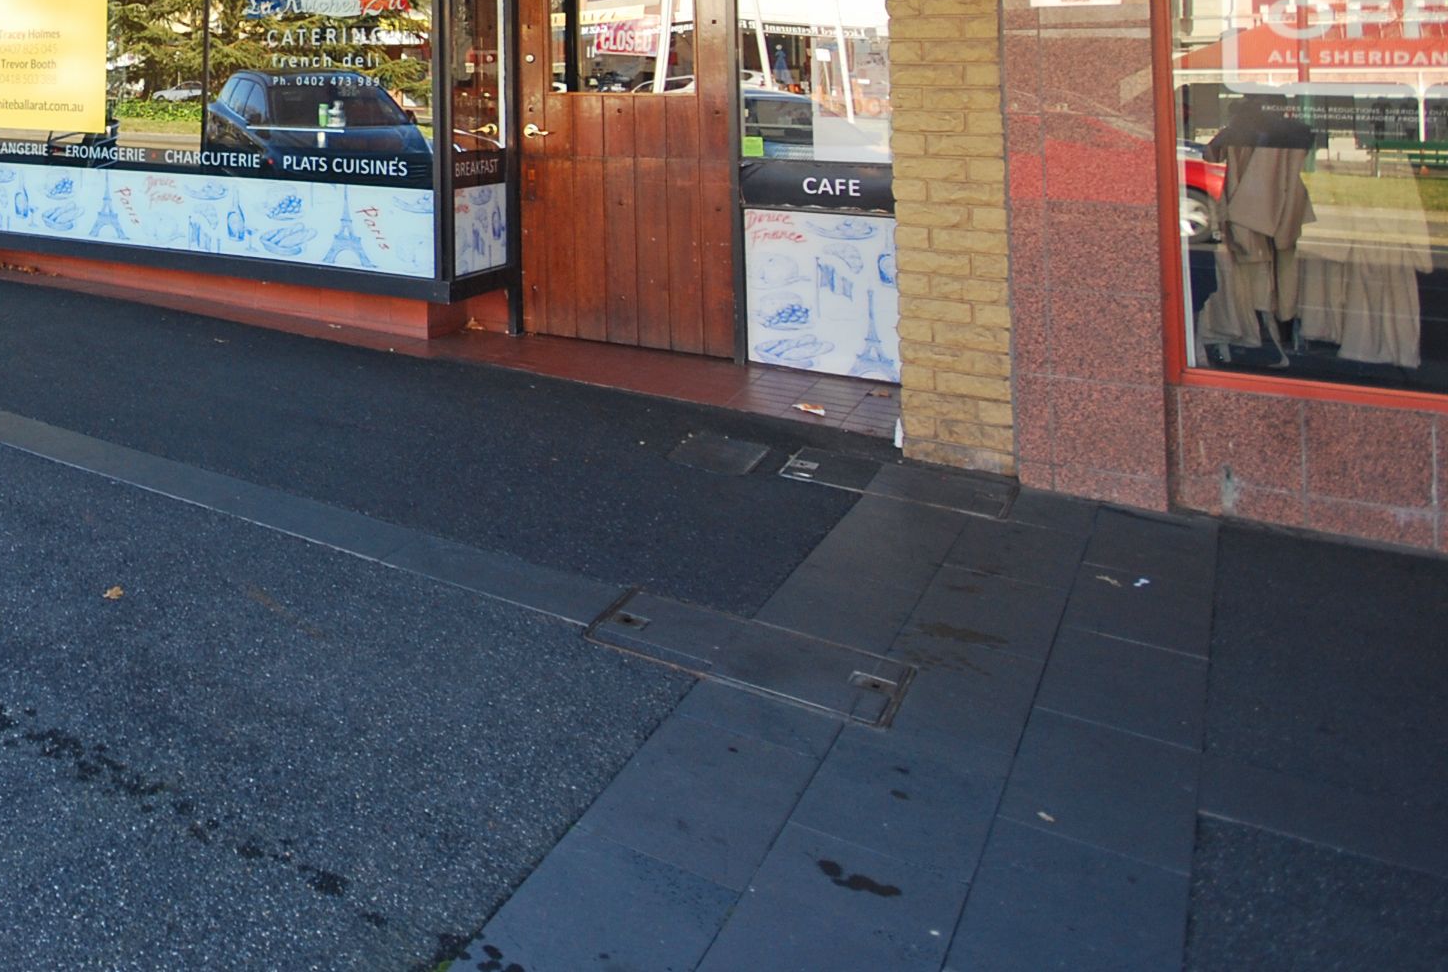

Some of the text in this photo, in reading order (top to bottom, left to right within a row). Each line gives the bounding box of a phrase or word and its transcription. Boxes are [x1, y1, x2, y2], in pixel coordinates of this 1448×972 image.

[28, 28, 61, 39] Holmes
[267, 27, 383, 47] CATERING
[600, 28, 652, 52] CLOSED
[1, 59, 57, 69] Trevor Booth
[273, 53, 380, 68] french deli
[1268, 50, 1448, 65] ALL SHERIDAN
[273, 77, 380, 87] Ph. 0402 473 989
[164, 150, 260, 168] CHARCUTERIE
[283, 155, 327, 172] PLATS
[455, 158, 499, 178] BREAKFAST
[802, 176, 861, 197] CAFE
[356, 205, 390, 251] Paris
